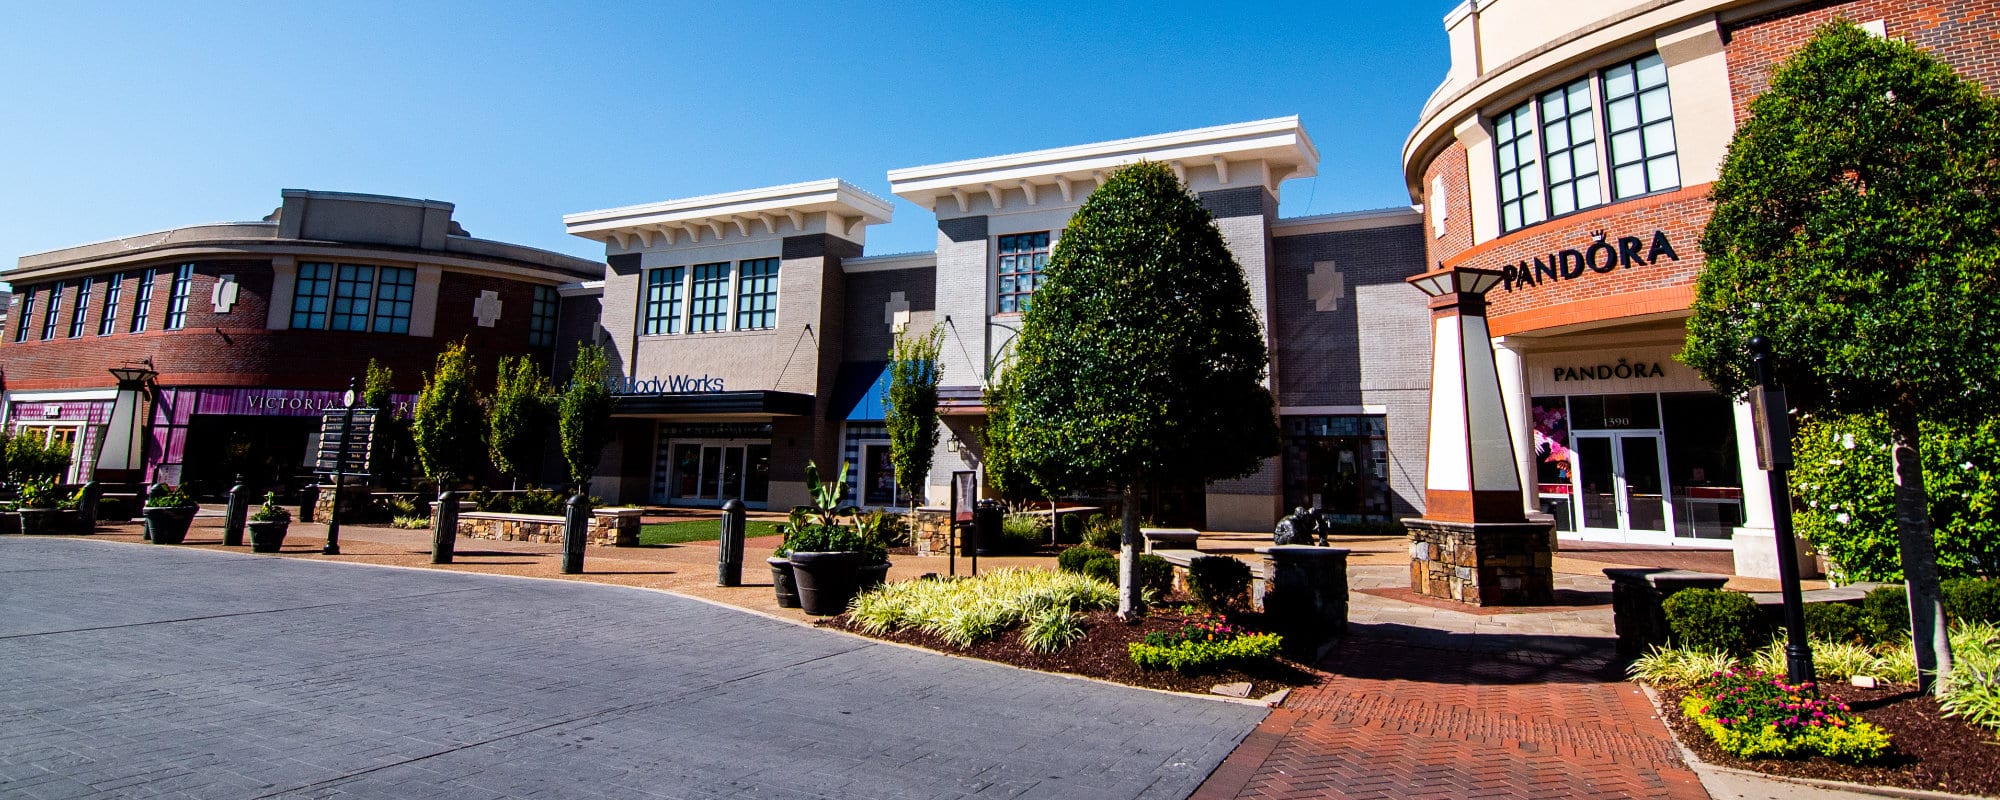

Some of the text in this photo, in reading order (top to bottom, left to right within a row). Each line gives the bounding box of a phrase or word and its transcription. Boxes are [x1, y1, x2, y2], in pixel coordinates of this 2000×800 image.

[1502, 230, 1679, 292] PANDORA
[1553, 359, 1664, 381] PANDORA
[623, 375, 667, 396] Body
[669, 374, 724, 392] Works
[1603, 417, 1630, 428] 1390
